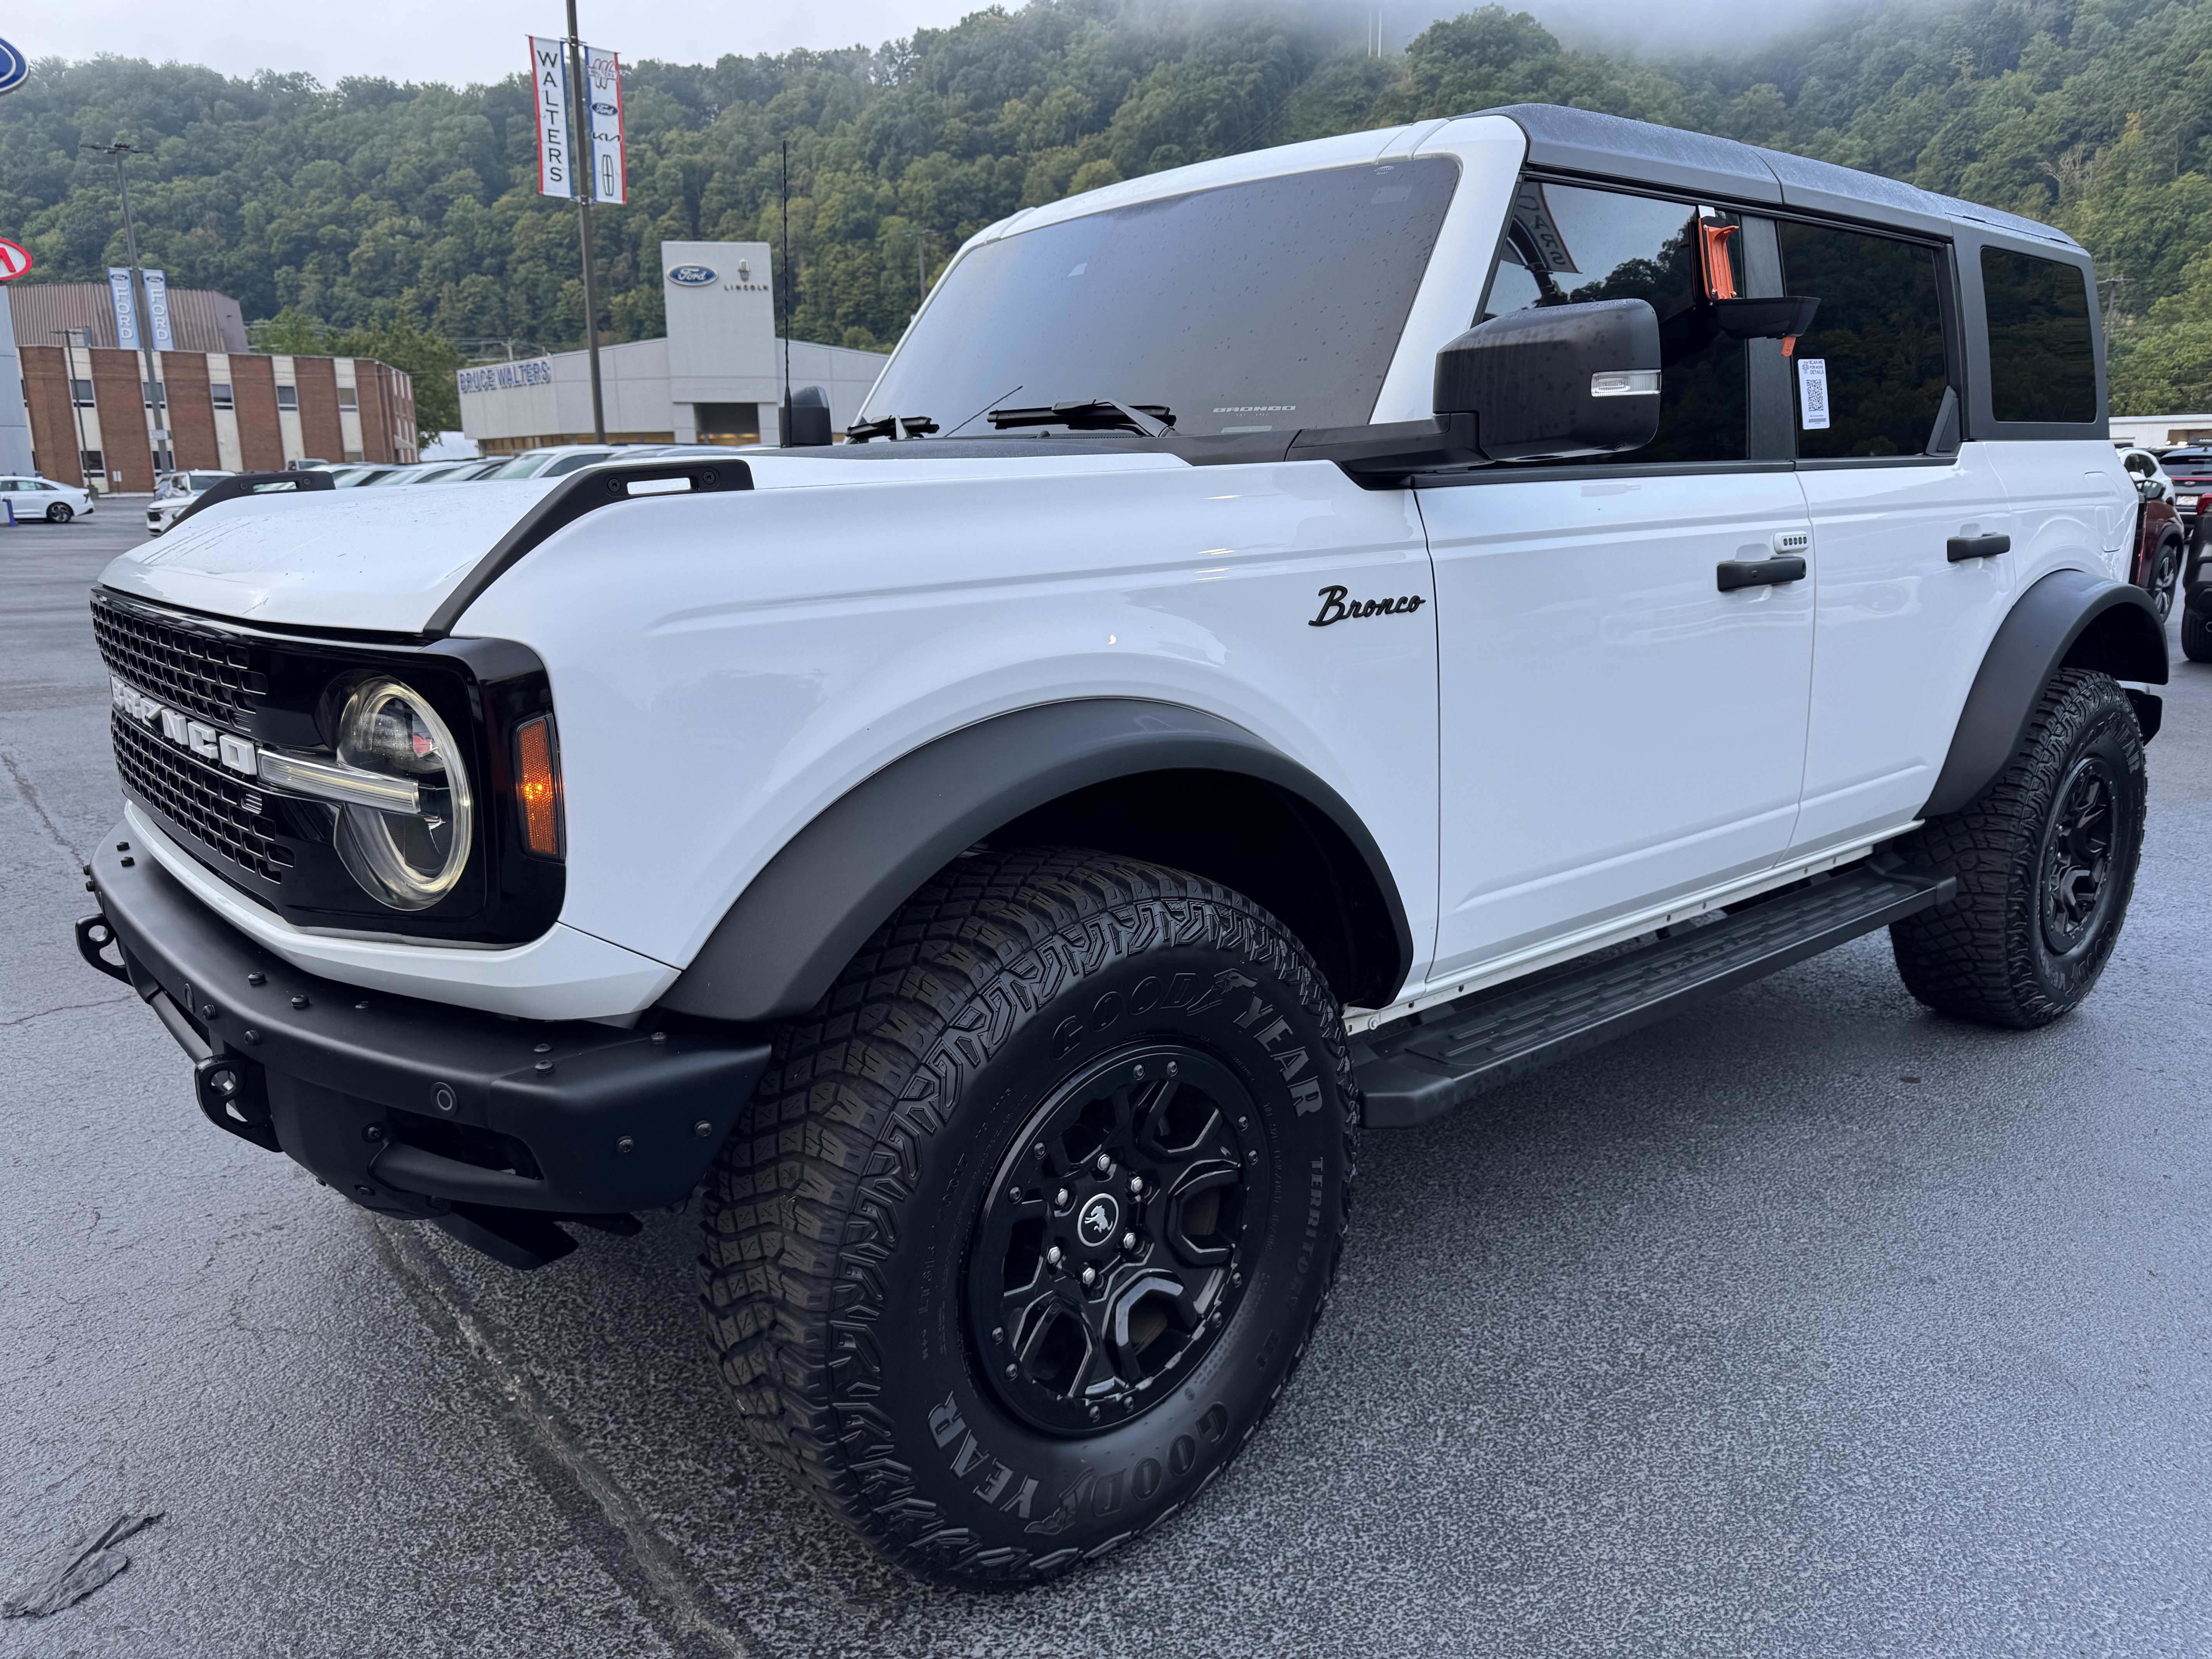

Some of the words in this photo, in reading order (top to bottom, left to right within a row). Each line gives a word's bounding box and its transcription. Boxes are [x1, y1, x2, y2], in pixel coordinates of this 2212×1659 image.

[537, 50, 562, 182] WALTERS
[678, 268, 707, 281] Ford
[115, 287, 133, 339] FORD
[151, 289, 169, 340] FORD
[460, 369, 495, 391] BRUCE
[497, 361, 550, 386] WALTERS
[1308, 585, 1426, 627] Bronco
